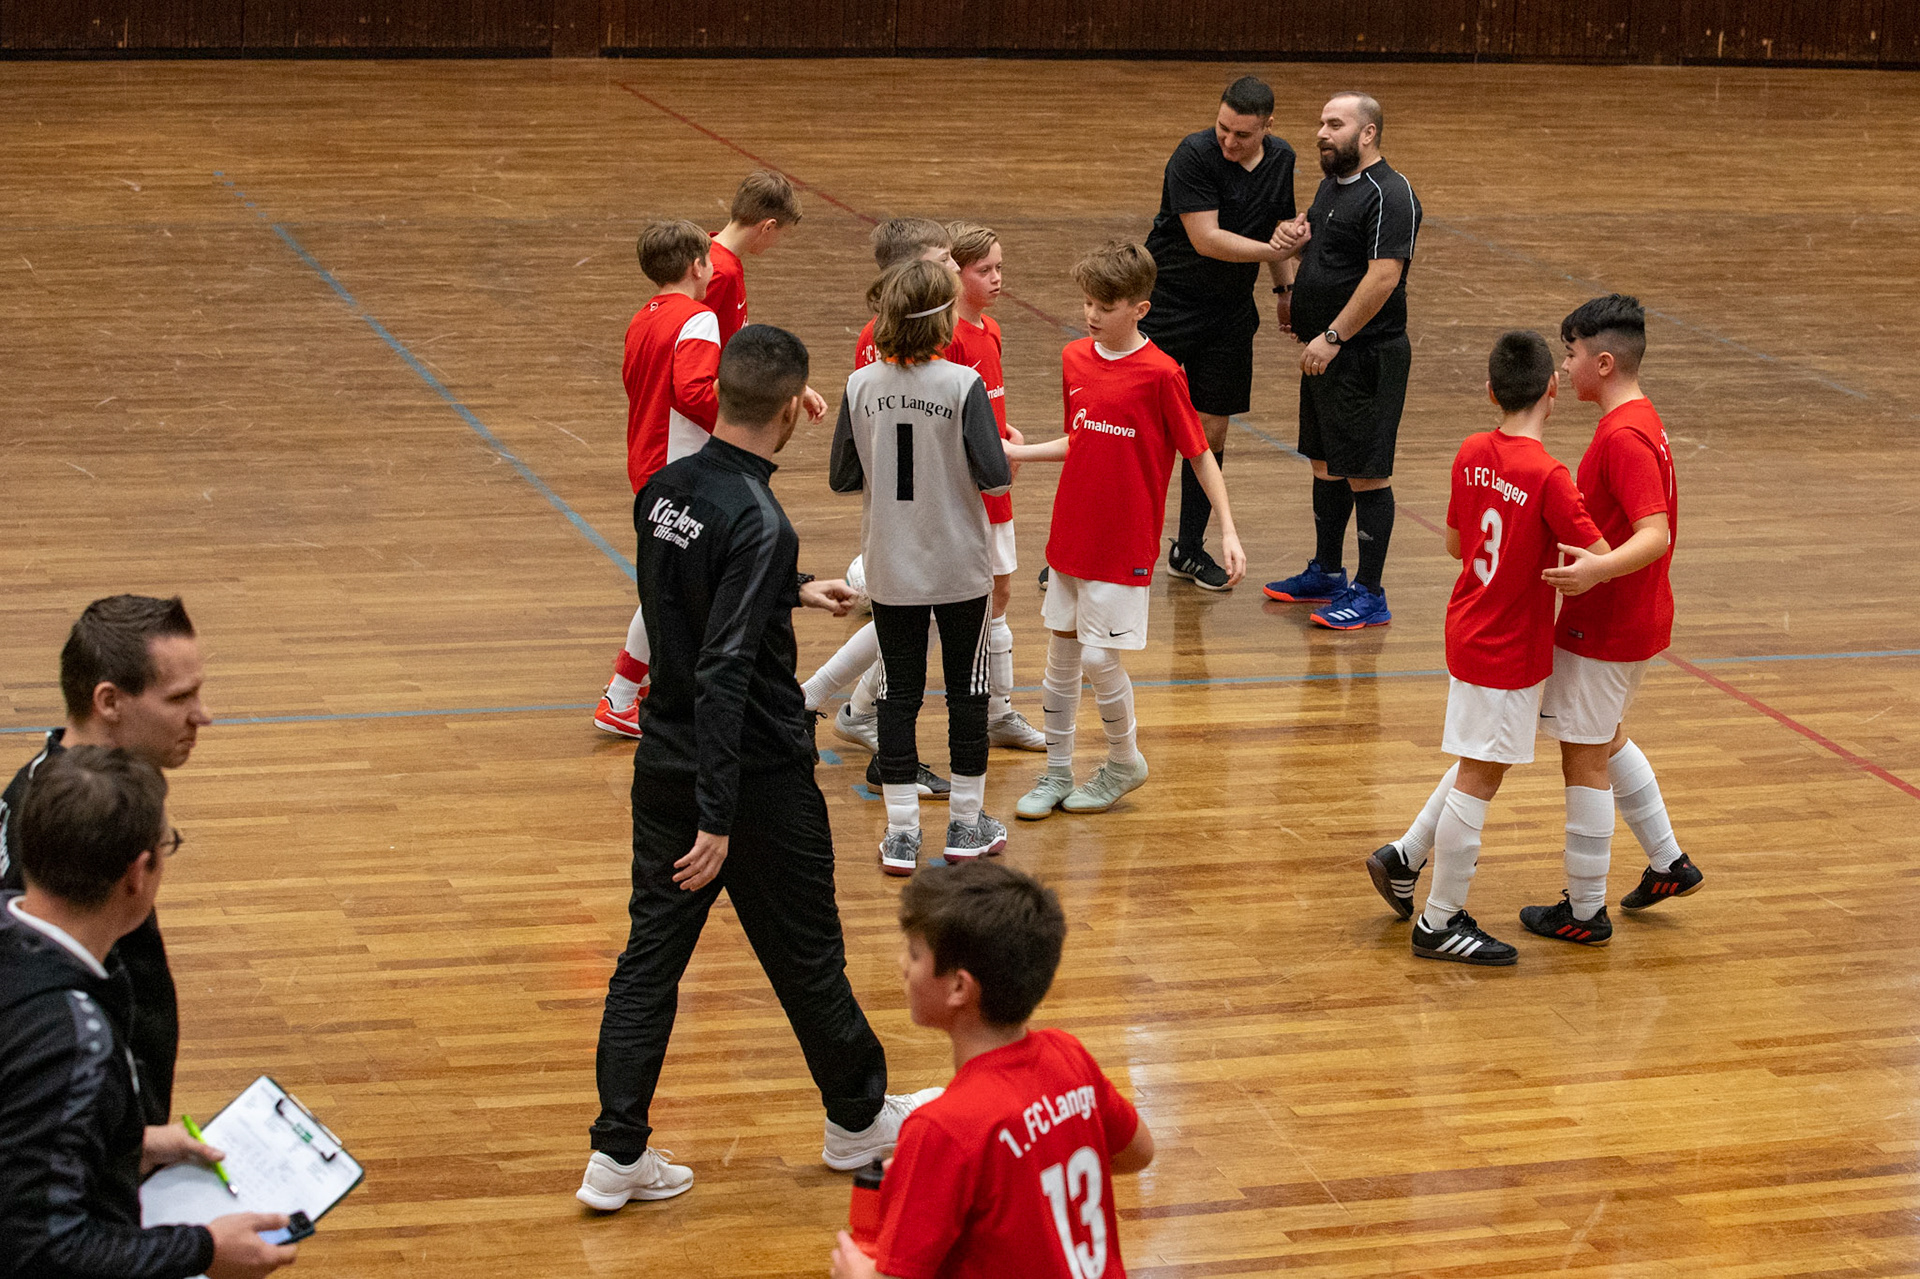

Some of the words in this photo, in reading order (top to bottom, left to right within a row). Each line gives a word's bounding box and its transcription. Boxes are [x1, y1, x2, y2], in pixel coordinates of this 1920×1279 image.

[864, 405, 875, 418] 1.
[877, 395, 897, 412] FC
[901, 395, 953, 419] Langen
[1083, 420, 1136, 438] mainova
[896, 423, 914, 502] 1
[1464, 466, 1473, 486] 1.
[1474, 466, 1490, 487] FC
[1491, 469, 1528, 507] Langen
[653, 524, 690, 550] Offeach
[1473, 507, 1503, 587] 3
[999, 1128, 1031, 1158] 1.
[1022, 1101, 1051, 1143] FC
[1040, 1145, 1107, 1279] 13
